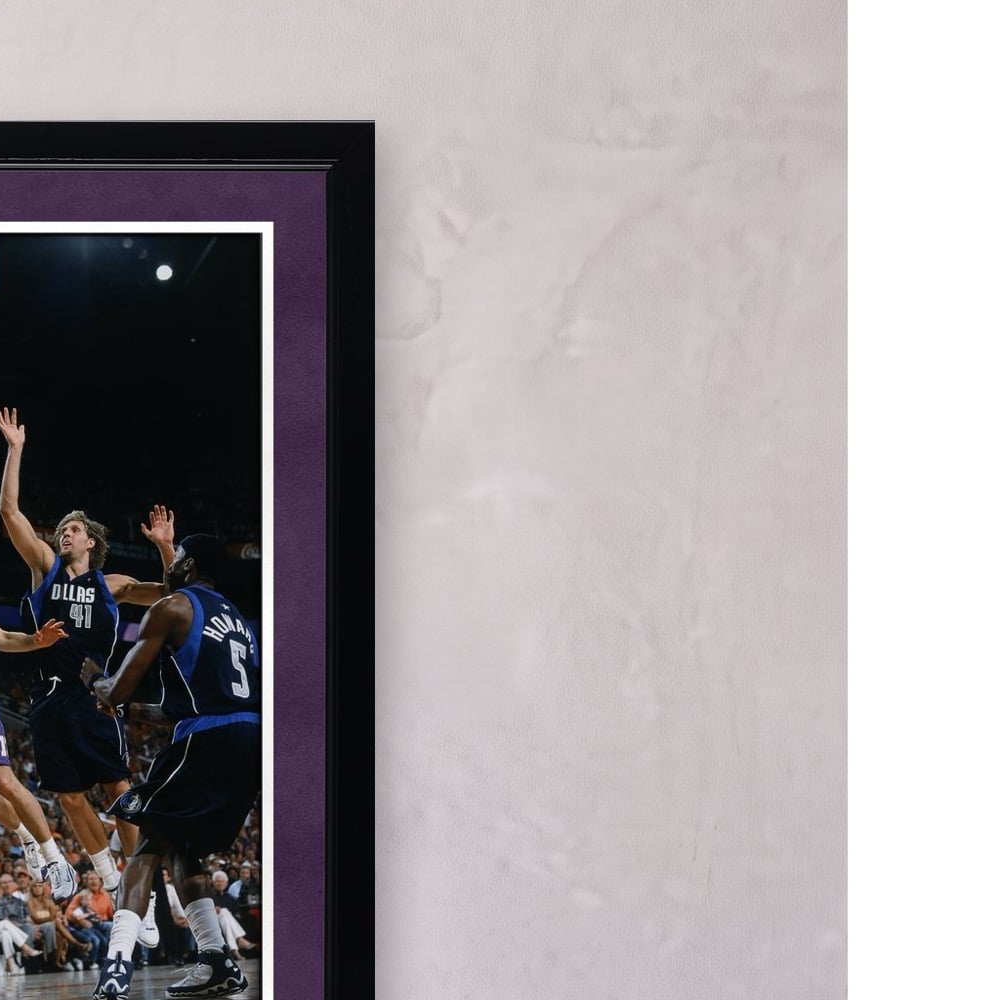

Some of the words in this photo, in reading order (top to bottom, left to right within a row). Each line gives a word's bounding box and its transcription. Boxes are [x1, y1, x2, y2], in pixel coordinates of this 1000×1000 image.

[51, 583, 95, 603] DLLAS
[69, 603, 92, 629] 41
[229, 639, 250, 698] 5
